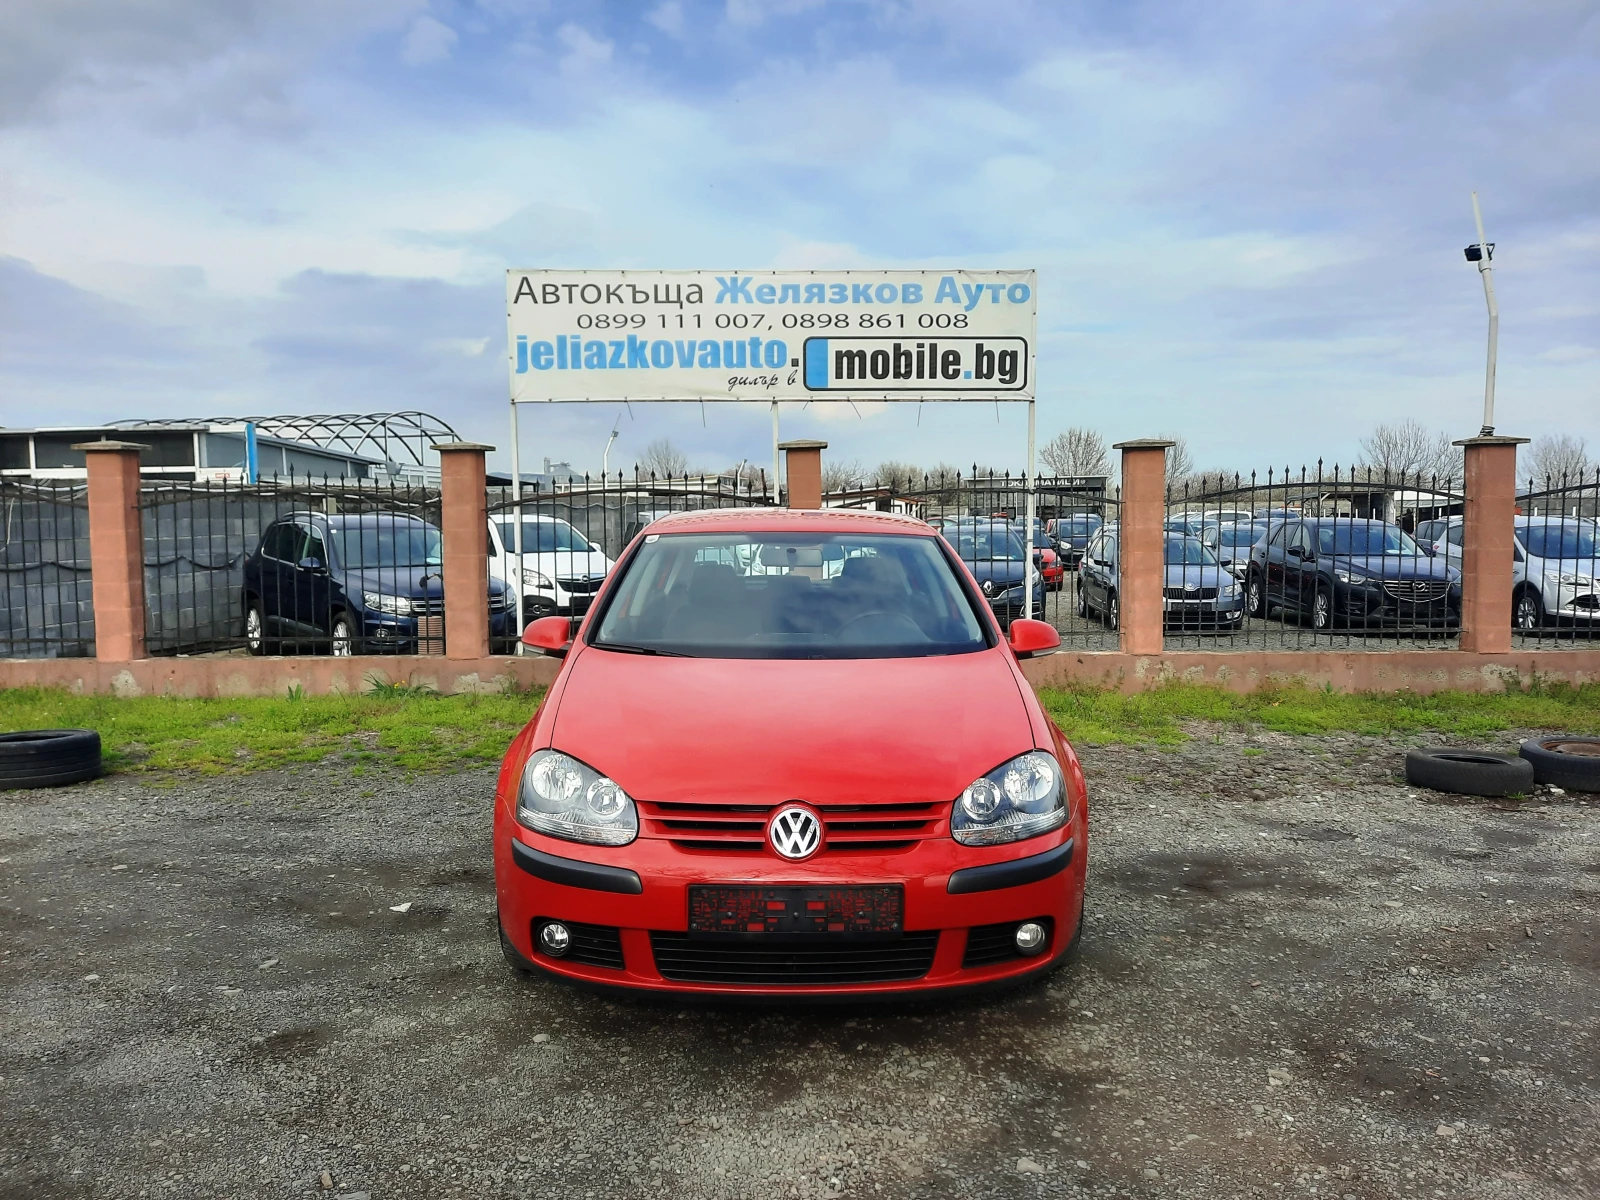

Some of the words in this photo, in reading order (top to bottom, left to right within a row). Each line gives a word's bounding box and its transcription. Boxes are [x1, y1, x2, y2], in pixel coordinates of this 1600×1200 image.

[513, 276, 703, 309] Автокъща
[714, 276, 924, 304] Желязков
[934, 276, 1031, 312] Ауто
[576, 313, 647, 329] 0899
[657, 313, 702, 329] 111
[714, 313, 773, 331] 007,
[781, 313, 850, 329] 0898
[858, 313, 905, 329] 861
[917, 313, 969, 329] 008
[834, 342, 1019, 384] mobile.bg
[727, 373, 778, 392] дилър
